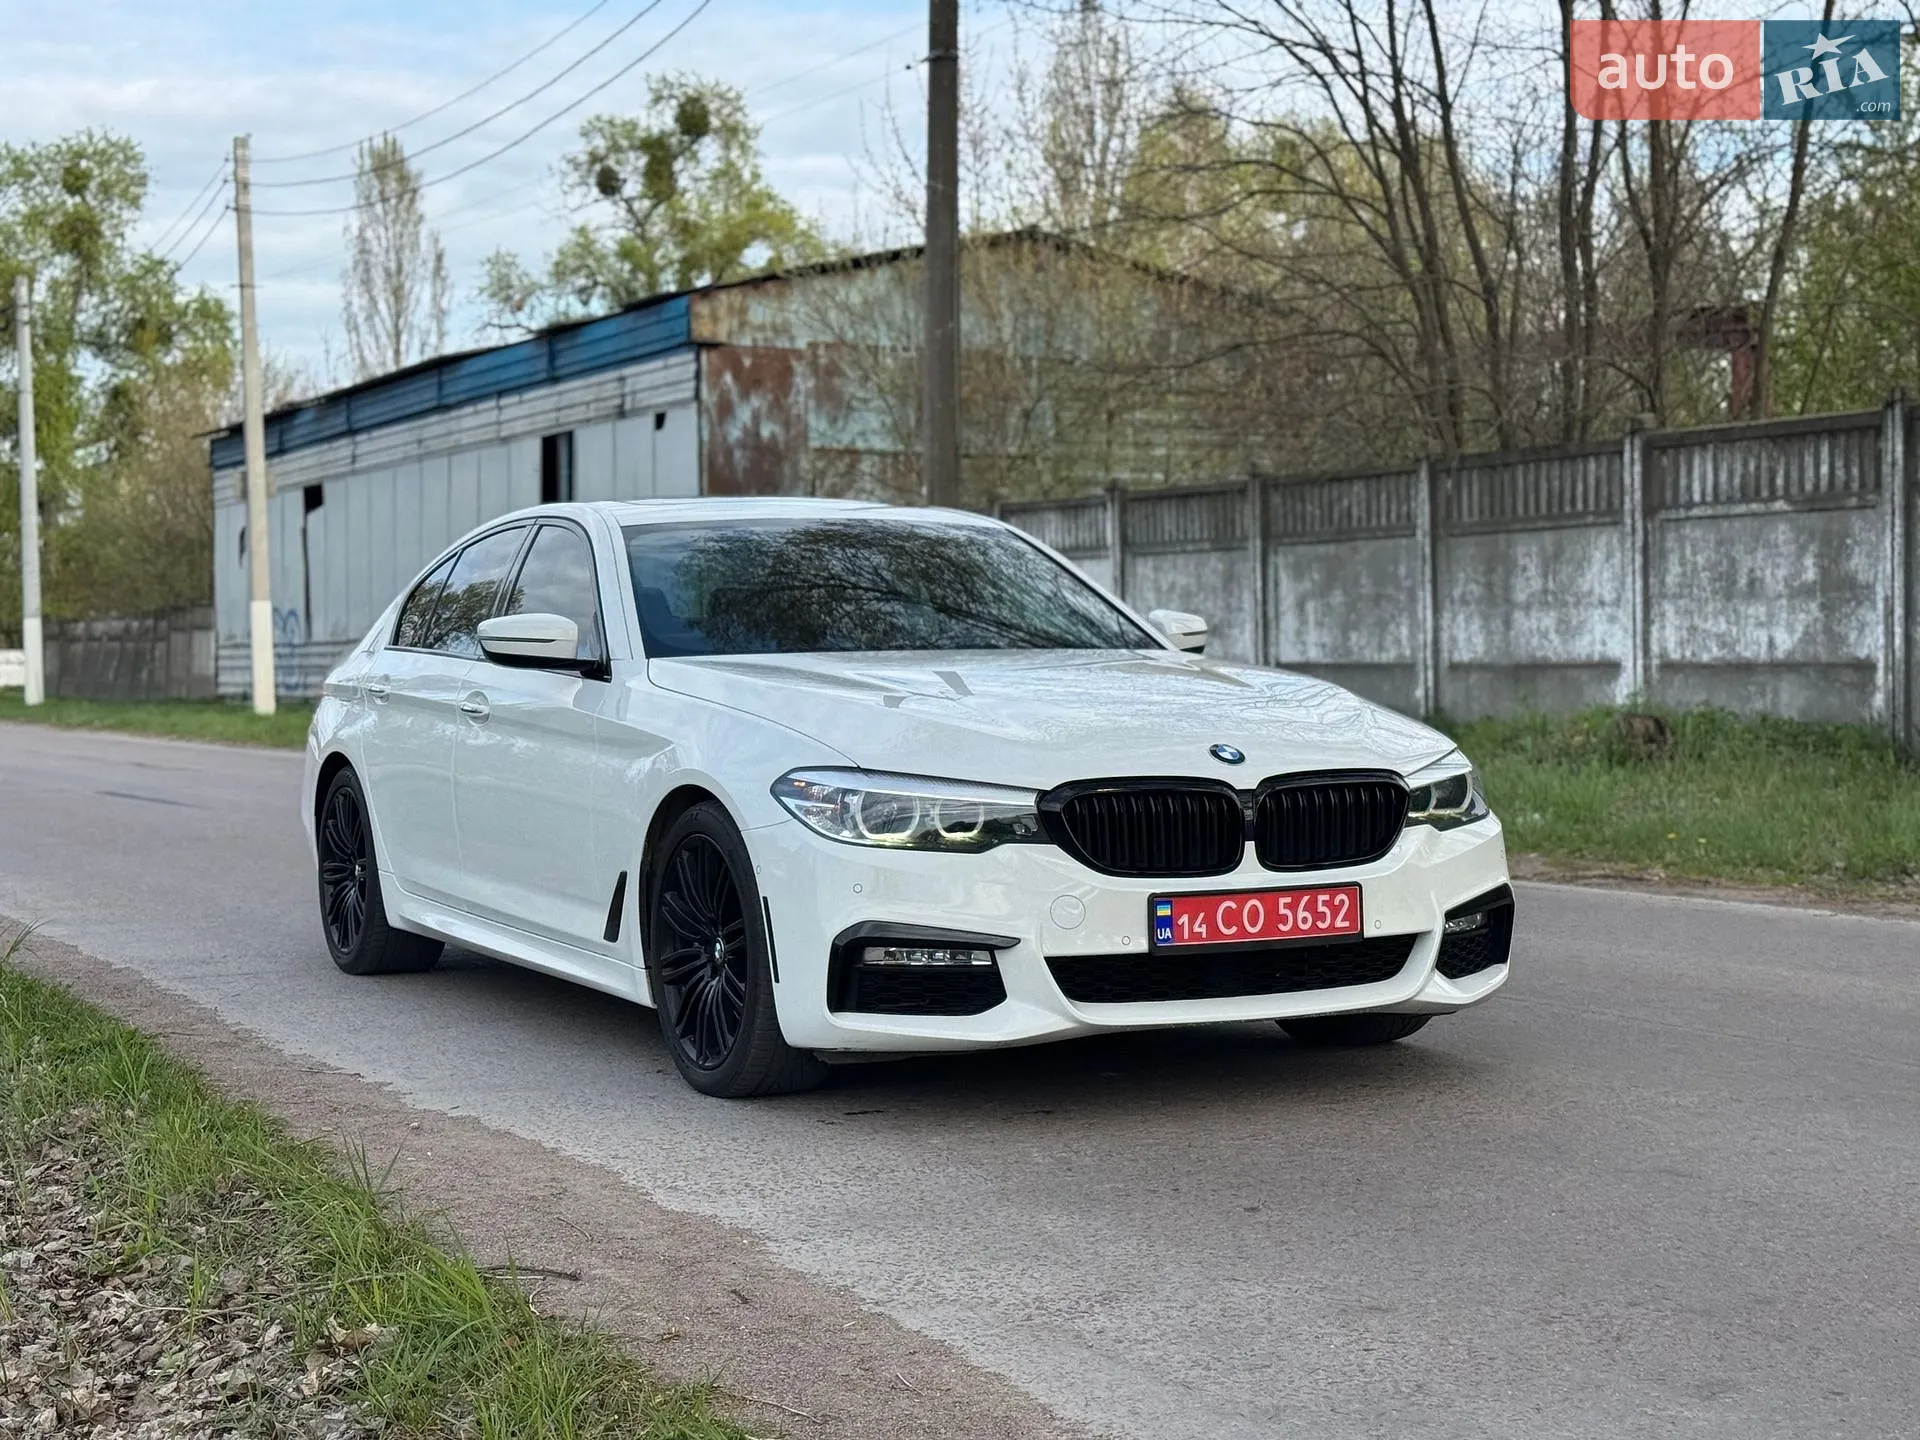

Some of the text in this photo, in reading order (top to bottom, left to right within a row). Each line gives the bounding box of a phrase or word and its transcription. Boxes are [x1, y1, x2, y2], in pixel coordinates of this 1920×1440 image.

[1177, 893, 1350, 940] 14 CO 5652
[1157, 927, 1172, 940] UA
